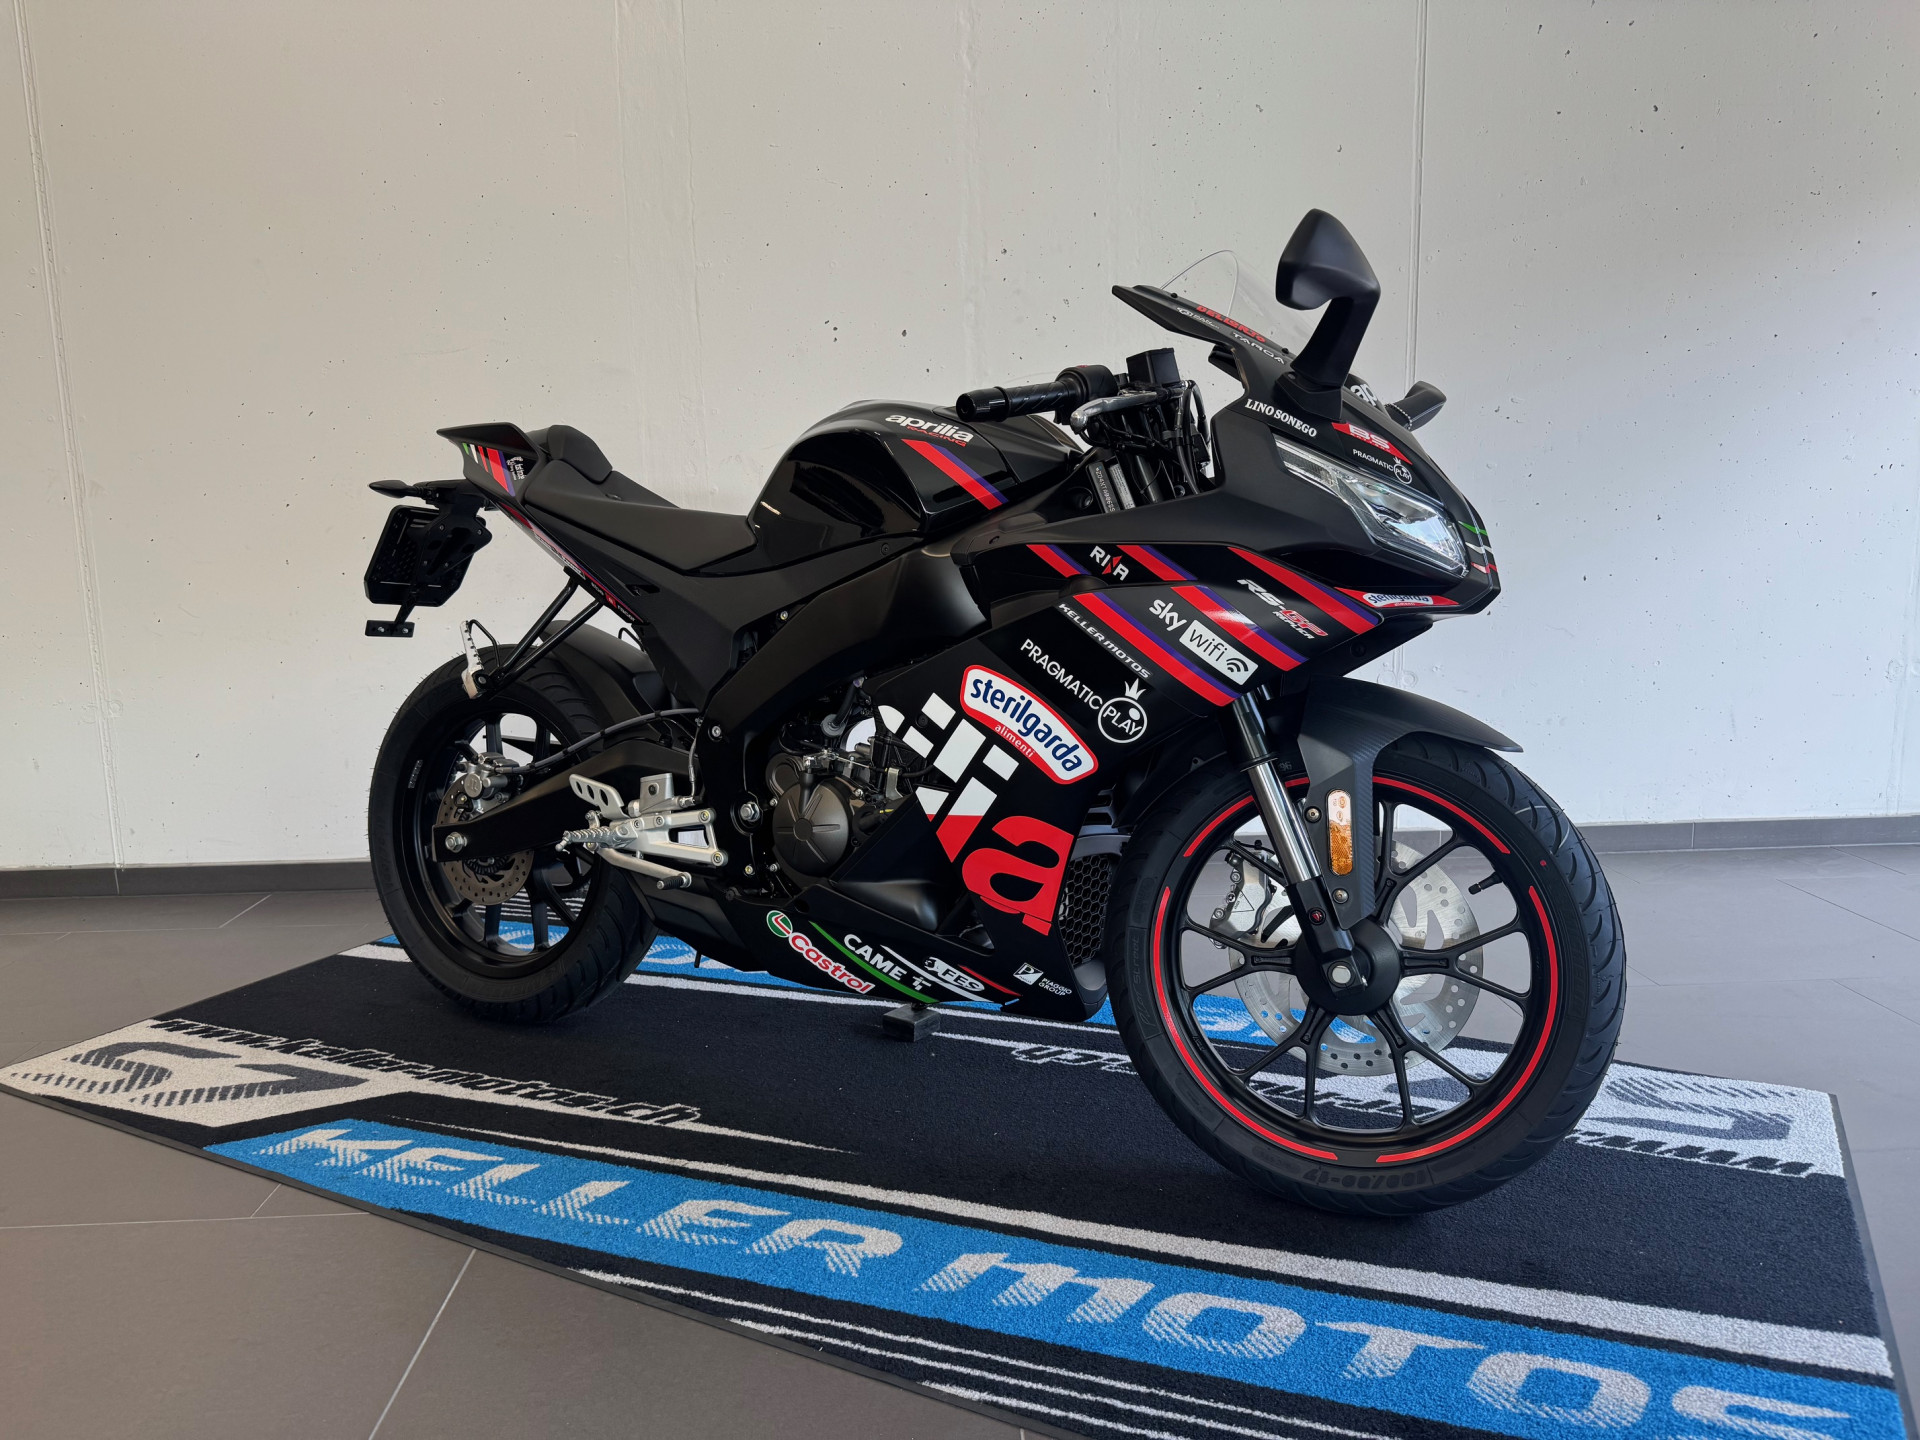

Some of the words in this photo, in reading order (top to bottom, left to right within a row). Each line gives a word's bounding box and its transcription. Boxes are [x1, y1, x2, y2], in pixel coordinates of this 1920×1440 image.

[885, 415, 974, 442] aprilia
[906, 426, 967, 447] RACING
[1245, 399, 1275, 416] LINO
[1273, 409, 1317, 438] SONEGO
[1349, 424, 1390, 449] BS
[1352, 449, 1394, 471] PRAGMATIC
[1395, 468, 1410, 480] PLAY
[1058, 603, 1107, 642] KELLER
[1102, 640, 1151, 679] MOTOS
[1149, 599, 1187, 631] sky
[1188, 628, 1228, 662] wifi
[1272, 611, 1315, 639] REPLICA
[1020, 638, 1103, 710] PRAGMATIC
[1102, 706, 1142, 736] PLAY
[970, 679, 1082, 772] sterilgarda
[994, 724, 1036, 758] alimenti
[789, 932, 875, 994] Castrol
[843, 933, 907, 981] CAME
[1038, 982, 1066, 996] GROUP
[1041, 977, 1073, 995] PIAGGIO
[250, 1128, 904, 1278] KELLER
